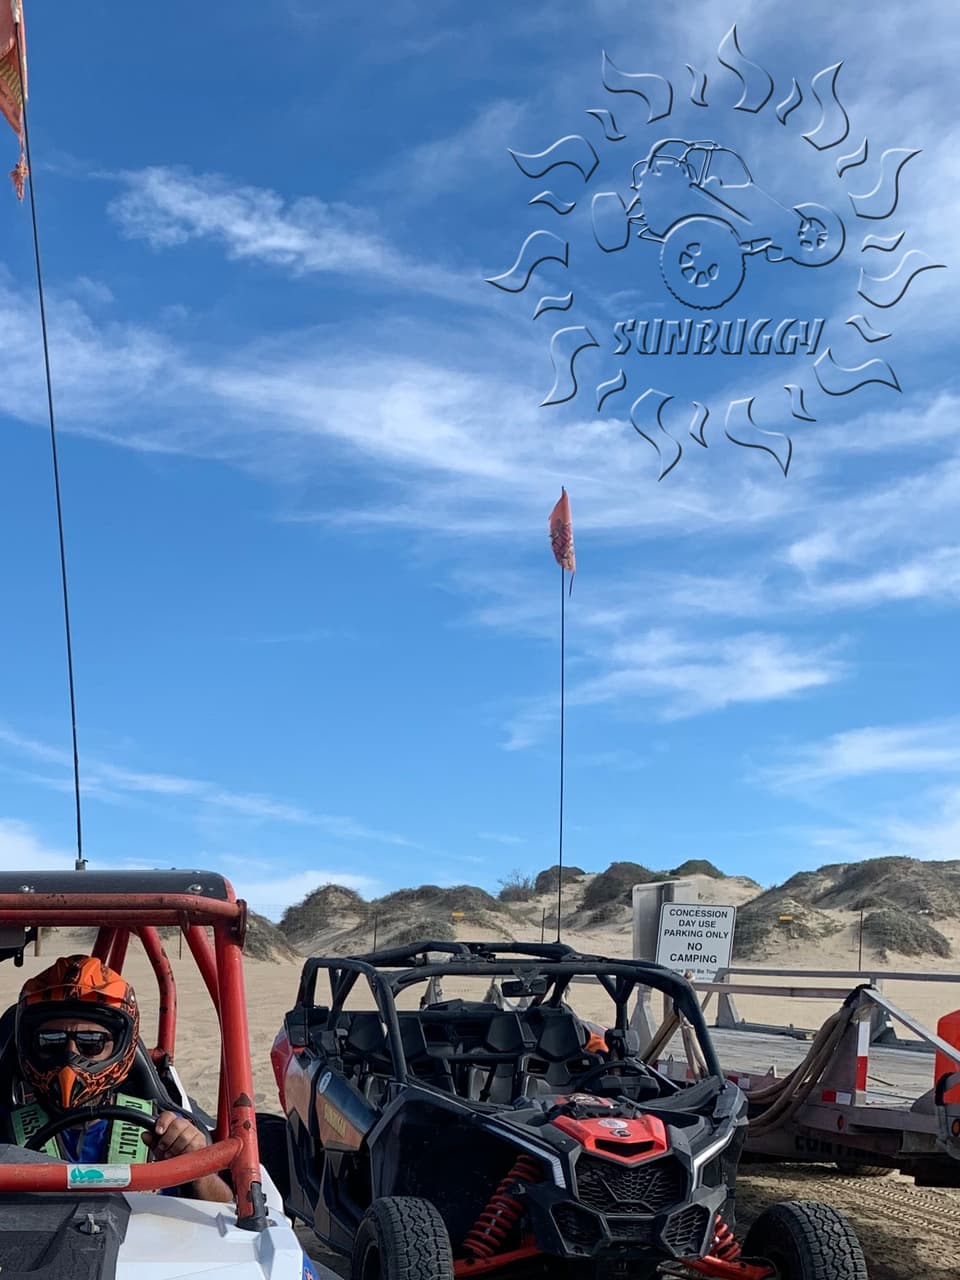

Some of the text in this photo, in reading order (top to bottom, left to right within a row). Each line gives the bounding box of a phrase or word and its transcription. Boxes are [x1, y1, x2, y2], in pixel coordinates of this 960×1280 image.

[669, 908, 728, 919] CONCESSION
[678, 919, 717, 929] DAY USE
[663, 929, 729, 939] PARKING ONLY
[687, 942, 703, 951] NO
[669, 953, 717, 964] CAMPING
